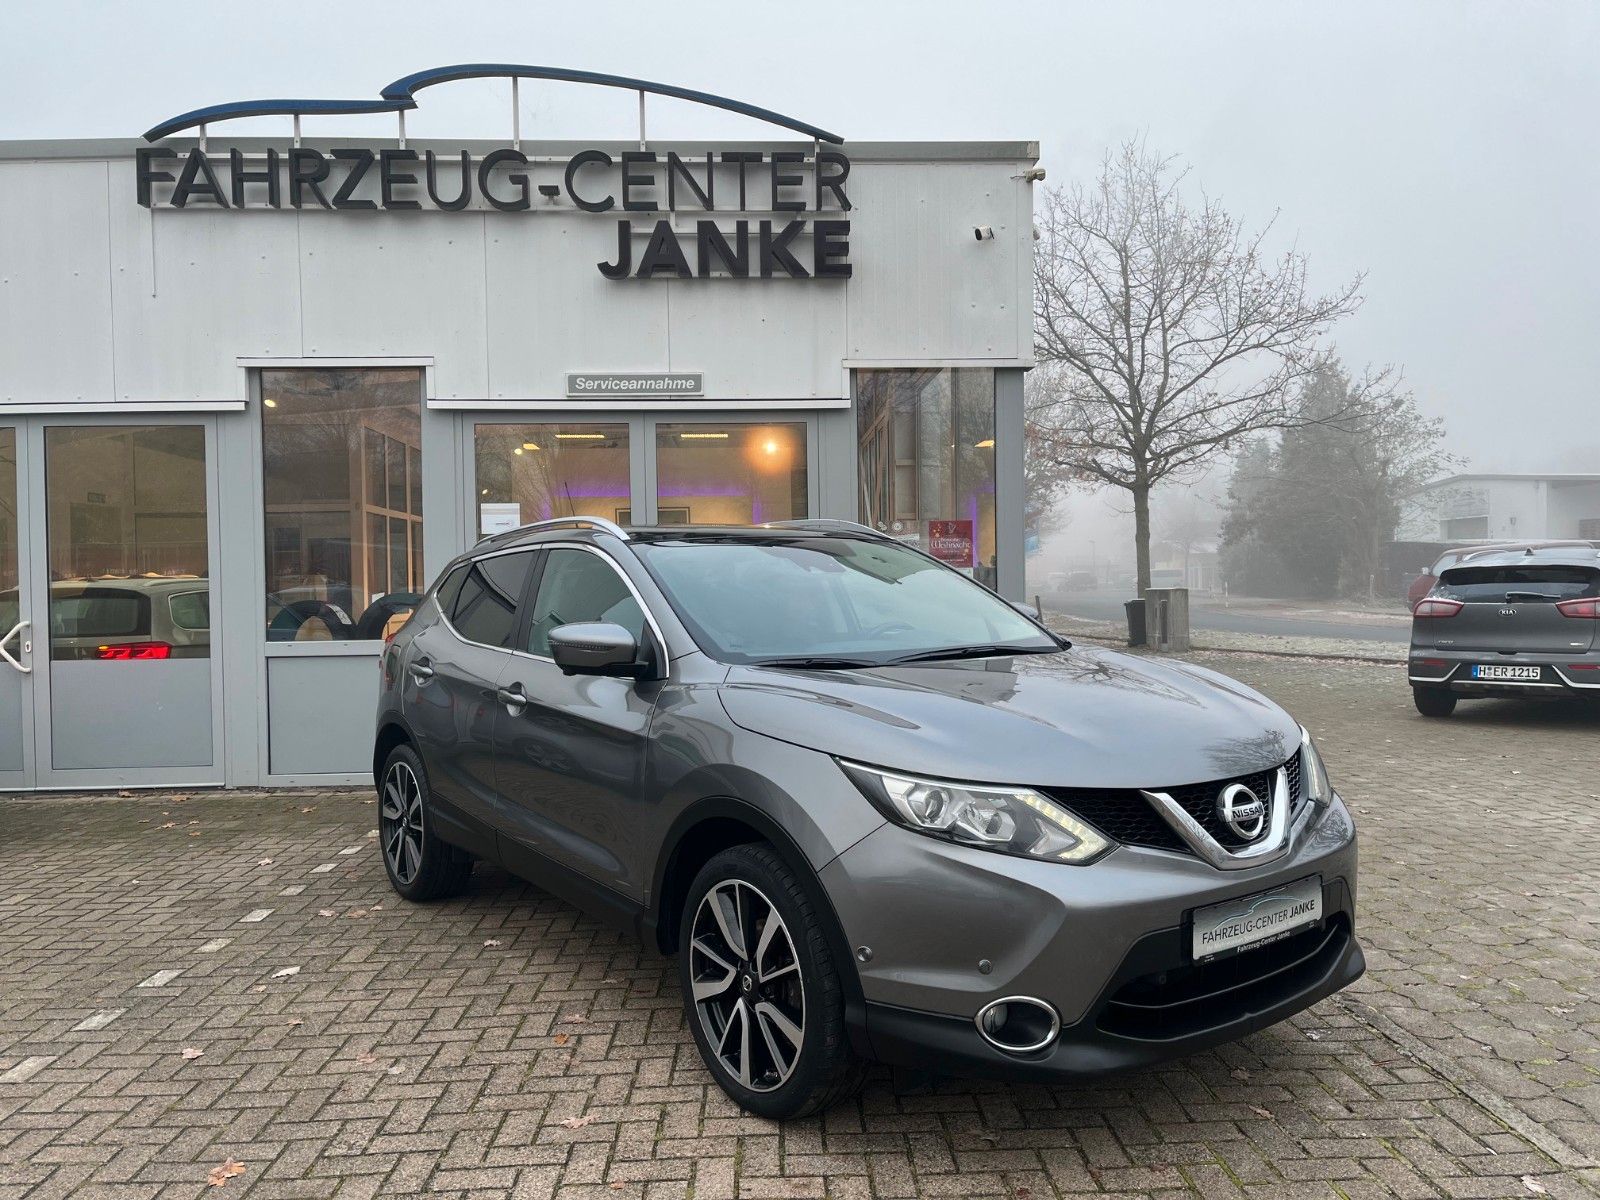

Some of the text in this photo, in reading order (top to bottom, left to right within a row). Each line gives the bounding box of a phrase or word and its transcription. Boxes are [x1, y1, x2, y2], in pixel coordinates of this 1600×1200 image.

[136, 148, 852, 212] FAHRZEUG-CENTER
[597, 220, 852, 280] JANKE
[575, 377, 695, 390] Serviceannahme
[1510, 667, 1539, 678] 1215
[1202, 909, 1288, 945] FAHRZEUG-CENTER
[1289, 899, 1315, 919] JANKE
